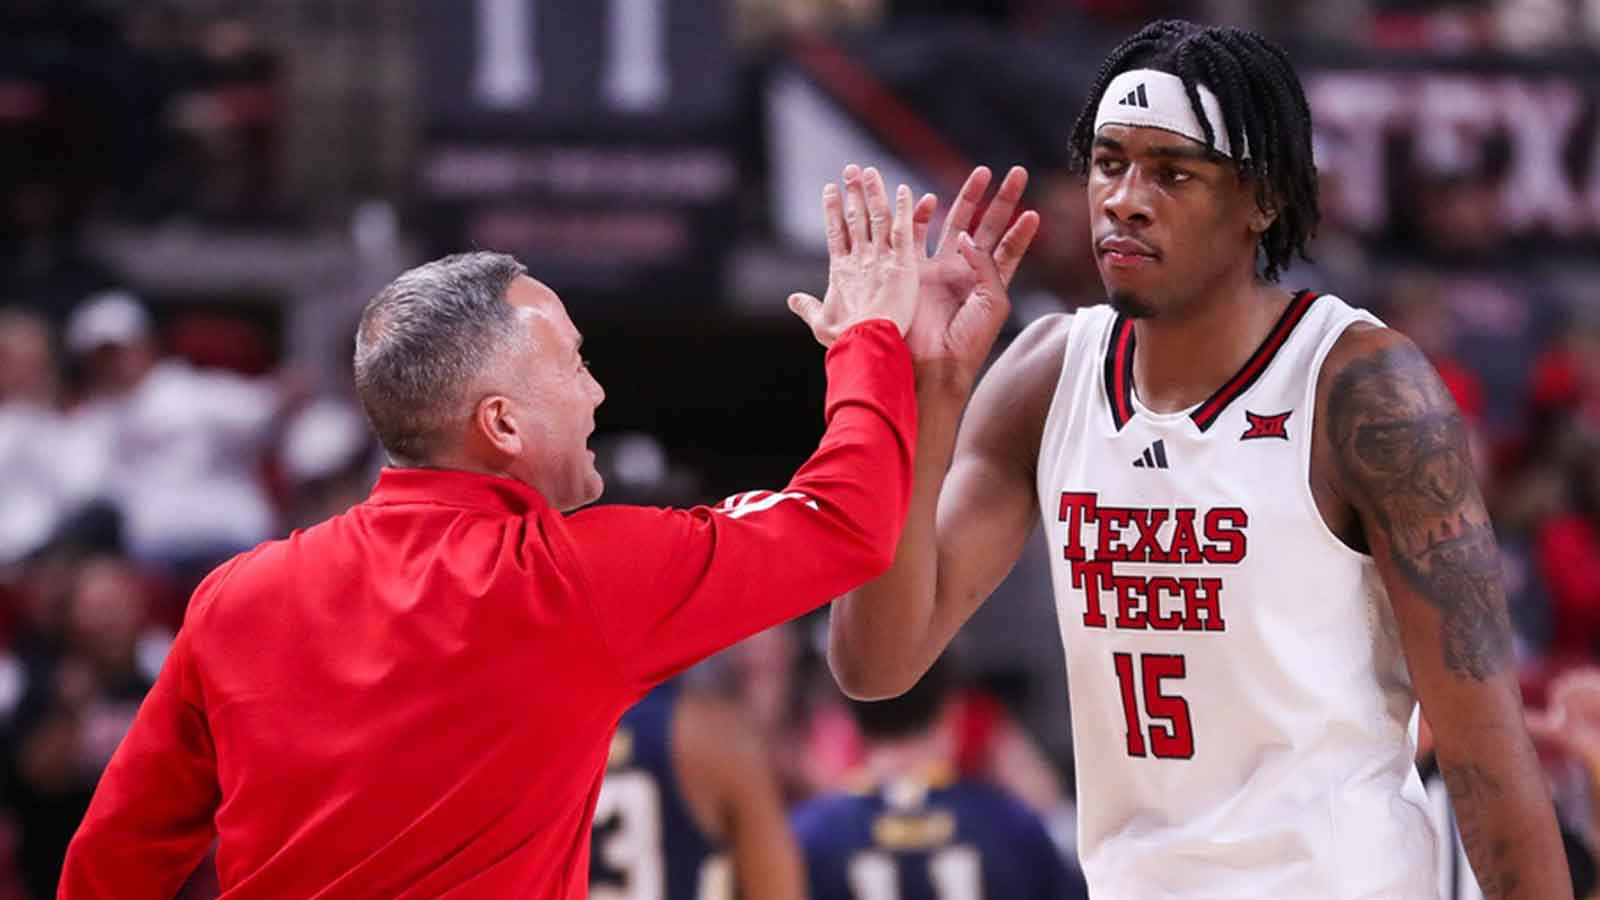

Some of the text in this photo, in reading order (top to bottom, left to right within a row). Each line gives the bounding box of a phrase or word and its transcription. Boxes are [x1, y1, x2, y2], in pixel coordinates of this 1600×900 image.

[1059, 491, 1248, 564] TEXAS
[1071, 560, 1225, 632] TECH
[1113, 652, 1195, 760] 15
